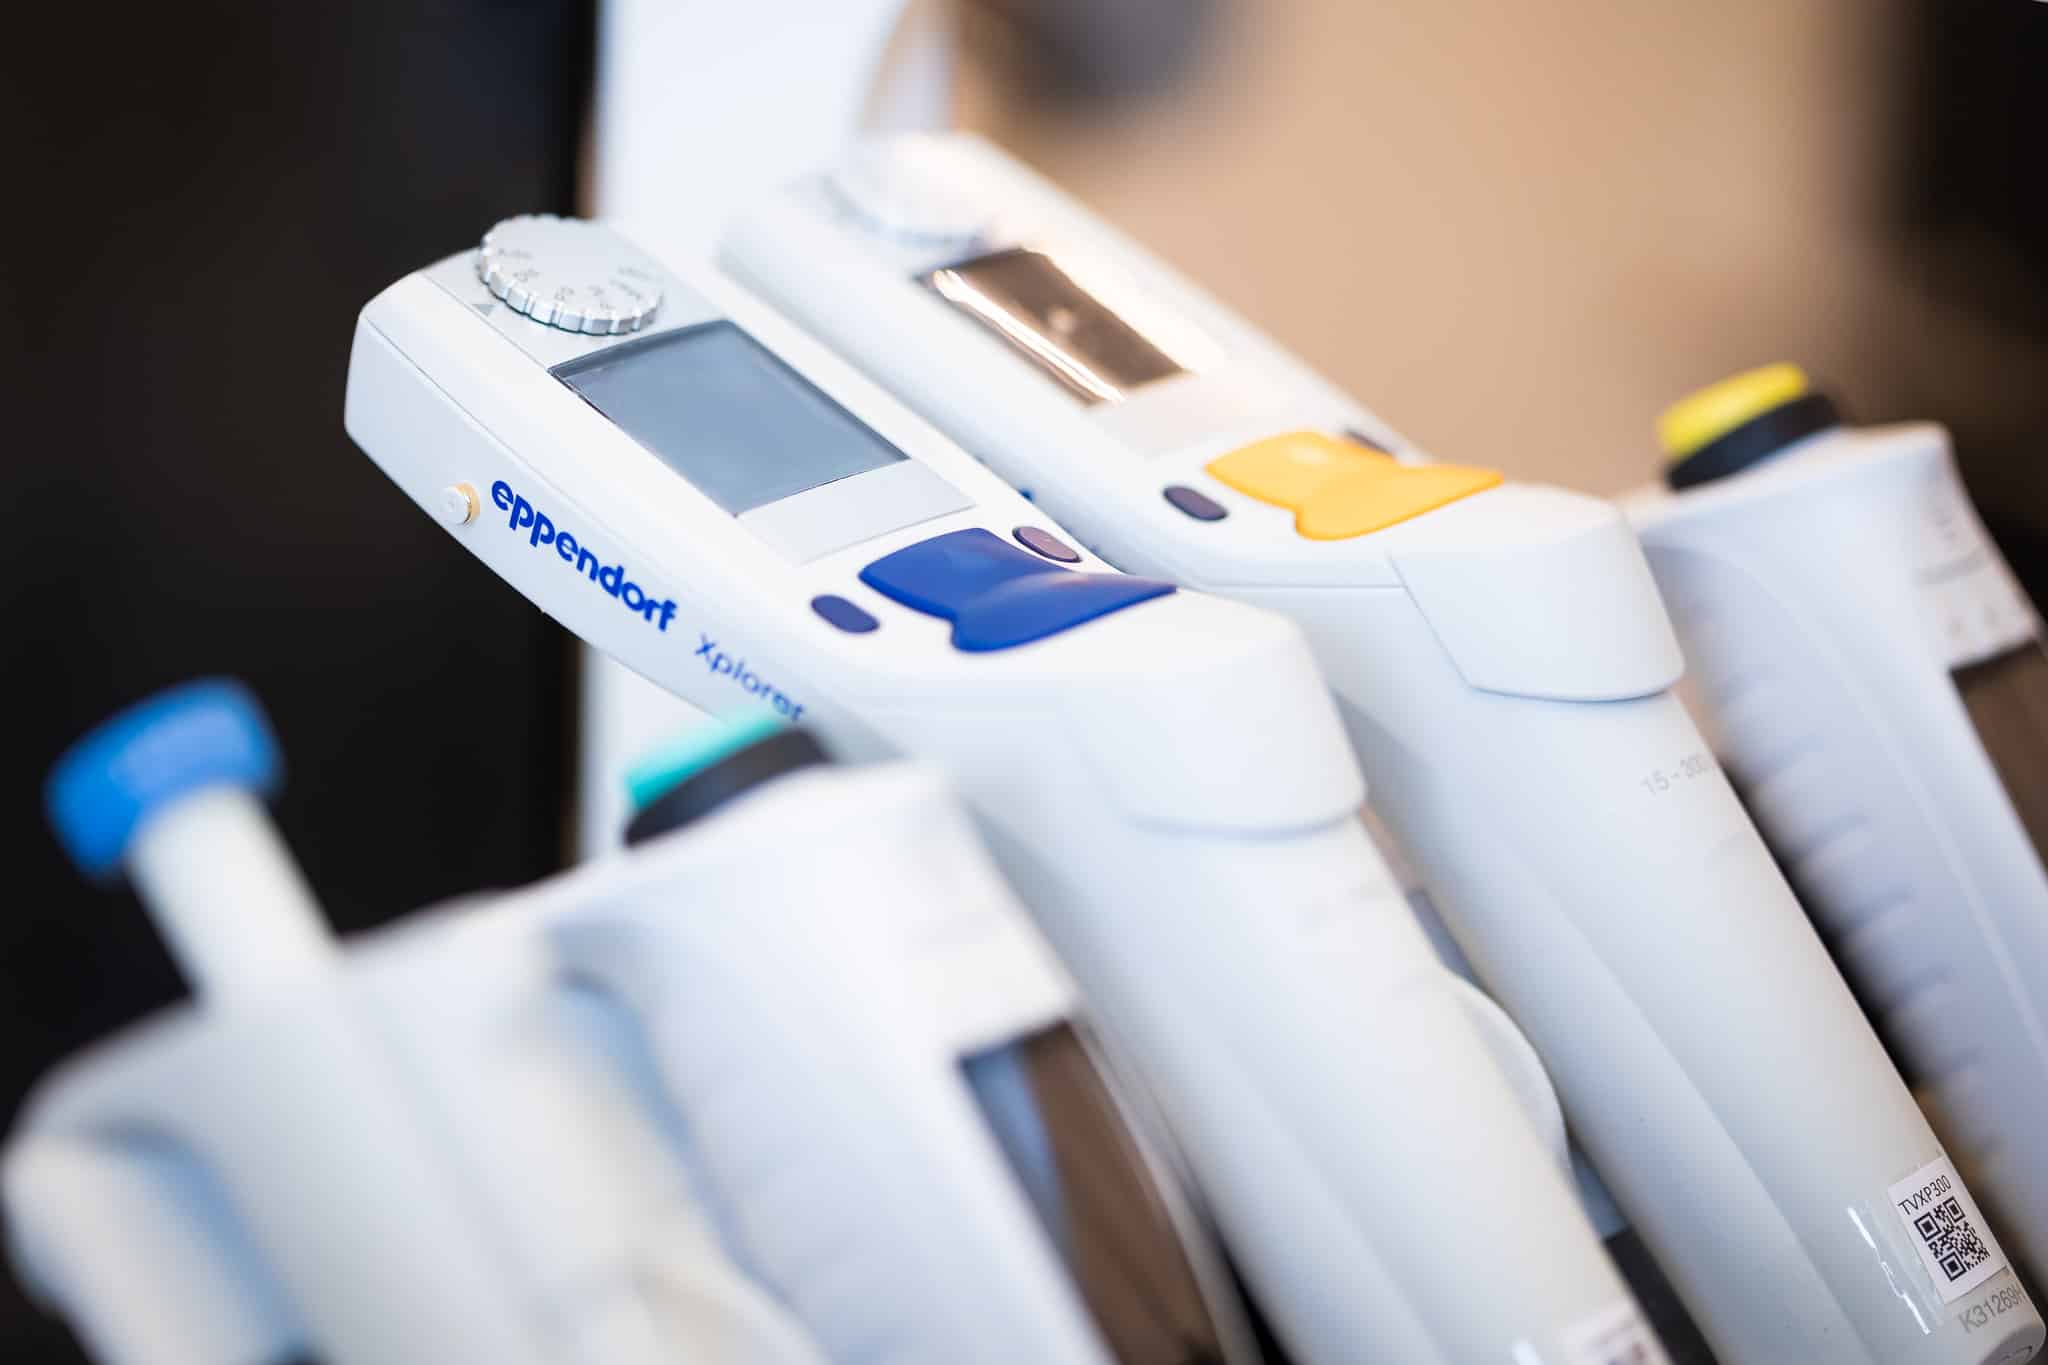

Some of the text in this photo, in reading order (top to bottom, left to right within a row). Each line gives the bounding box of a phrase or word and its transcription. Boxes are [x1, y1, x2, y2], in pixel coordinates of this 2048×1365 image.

[491, 480, 677, 632] eppendorf
[695, 632, 804, 721] Xplorer
[1898, 1174, 1952, 1215] TVXP300
